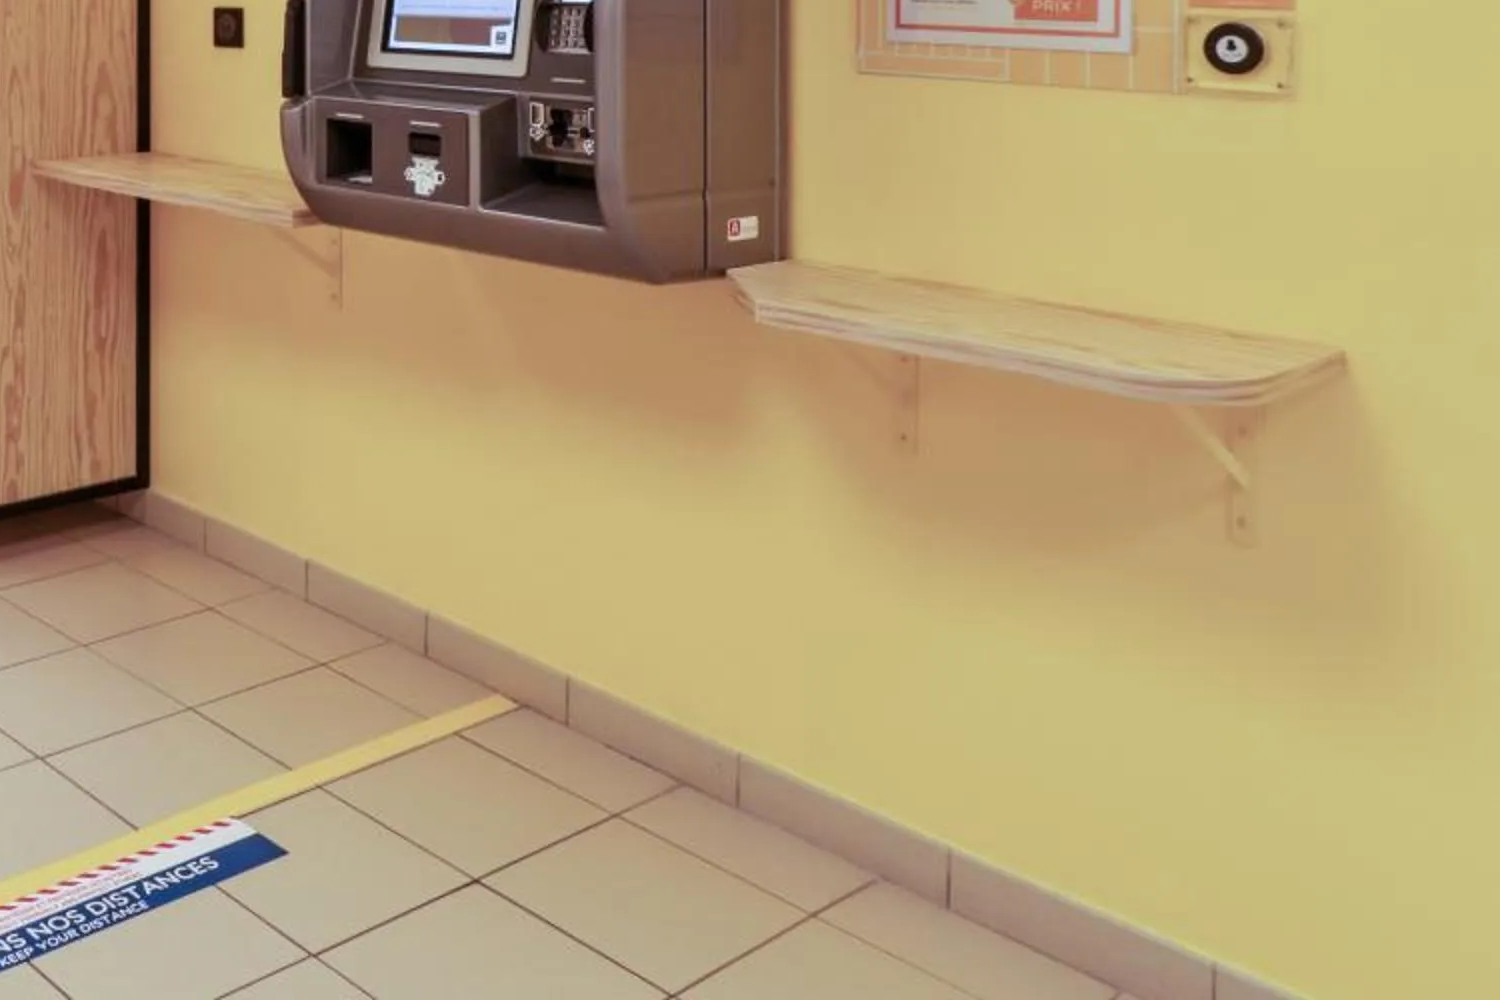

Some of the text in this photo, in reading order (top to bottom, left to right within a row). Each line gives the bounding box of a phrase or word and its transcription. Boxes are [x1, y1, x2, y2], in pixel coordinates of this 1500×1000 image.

[27, 908, 86, 943] NOS
[85, 855, 220, 916] DISTANCES
[36, 927, 81, 952] YOUR
[79, 900, 151, 936] DISTANCE
